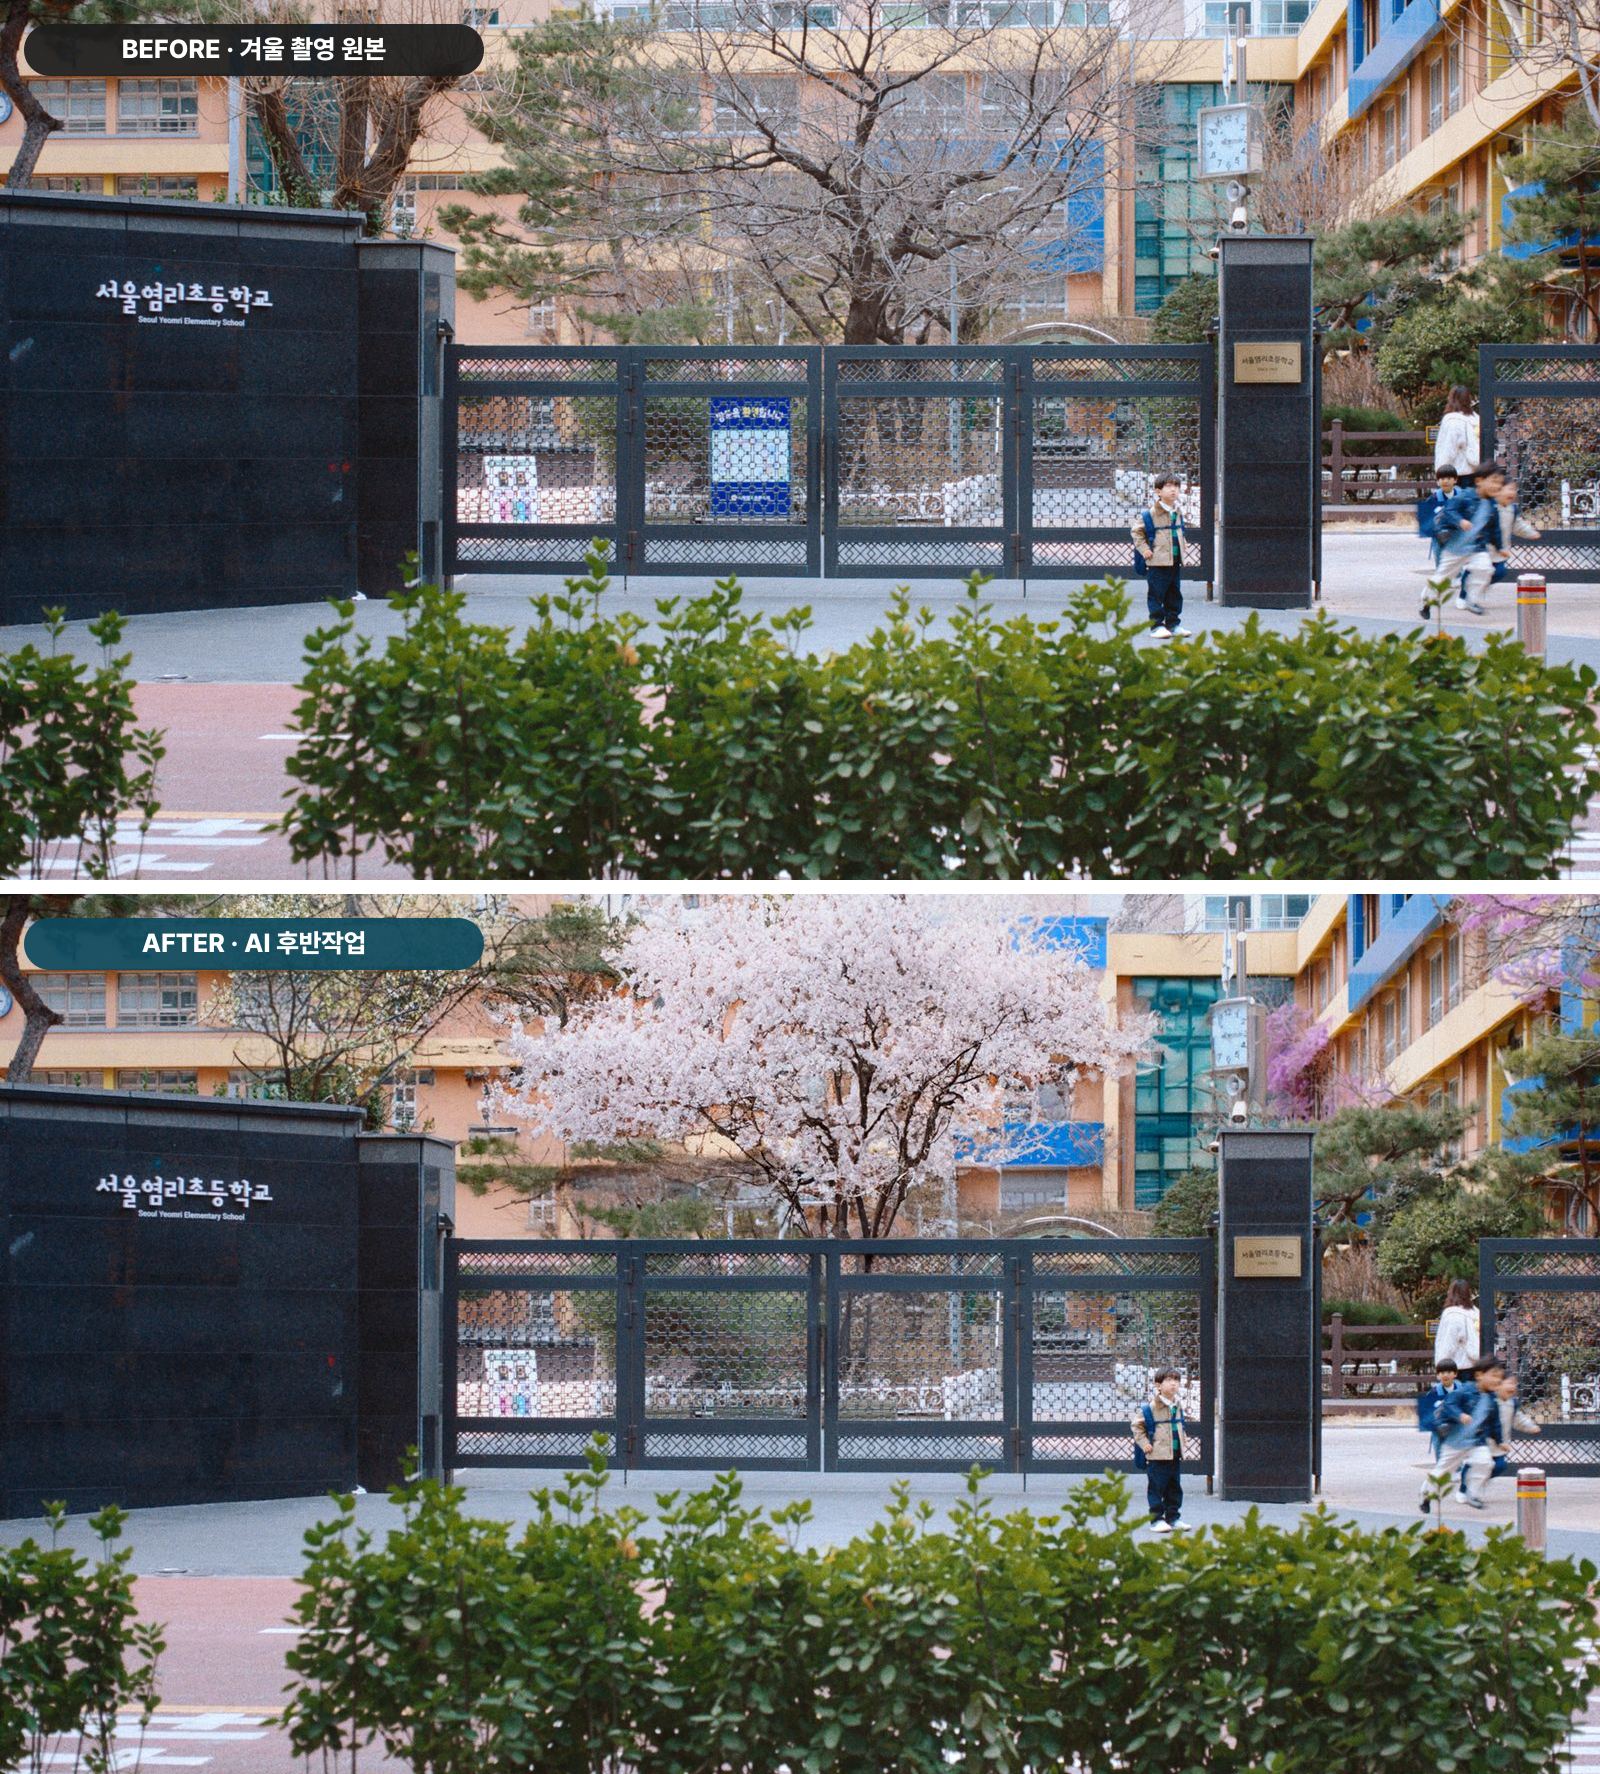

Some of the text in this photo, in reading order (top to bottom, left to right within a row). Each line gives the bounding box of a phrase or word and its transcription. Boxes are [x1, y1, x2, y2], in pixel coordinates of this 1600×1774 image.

[95, 280, 273, 315] 서울염리초등학교
[138, 315, 245, 327] Seoul Yeomri Elementary School
[95, 1174, 273, 1209] 서울염리초등학교
[138, 1209, 245, 1221] Seoul Yeomri Elementary School
